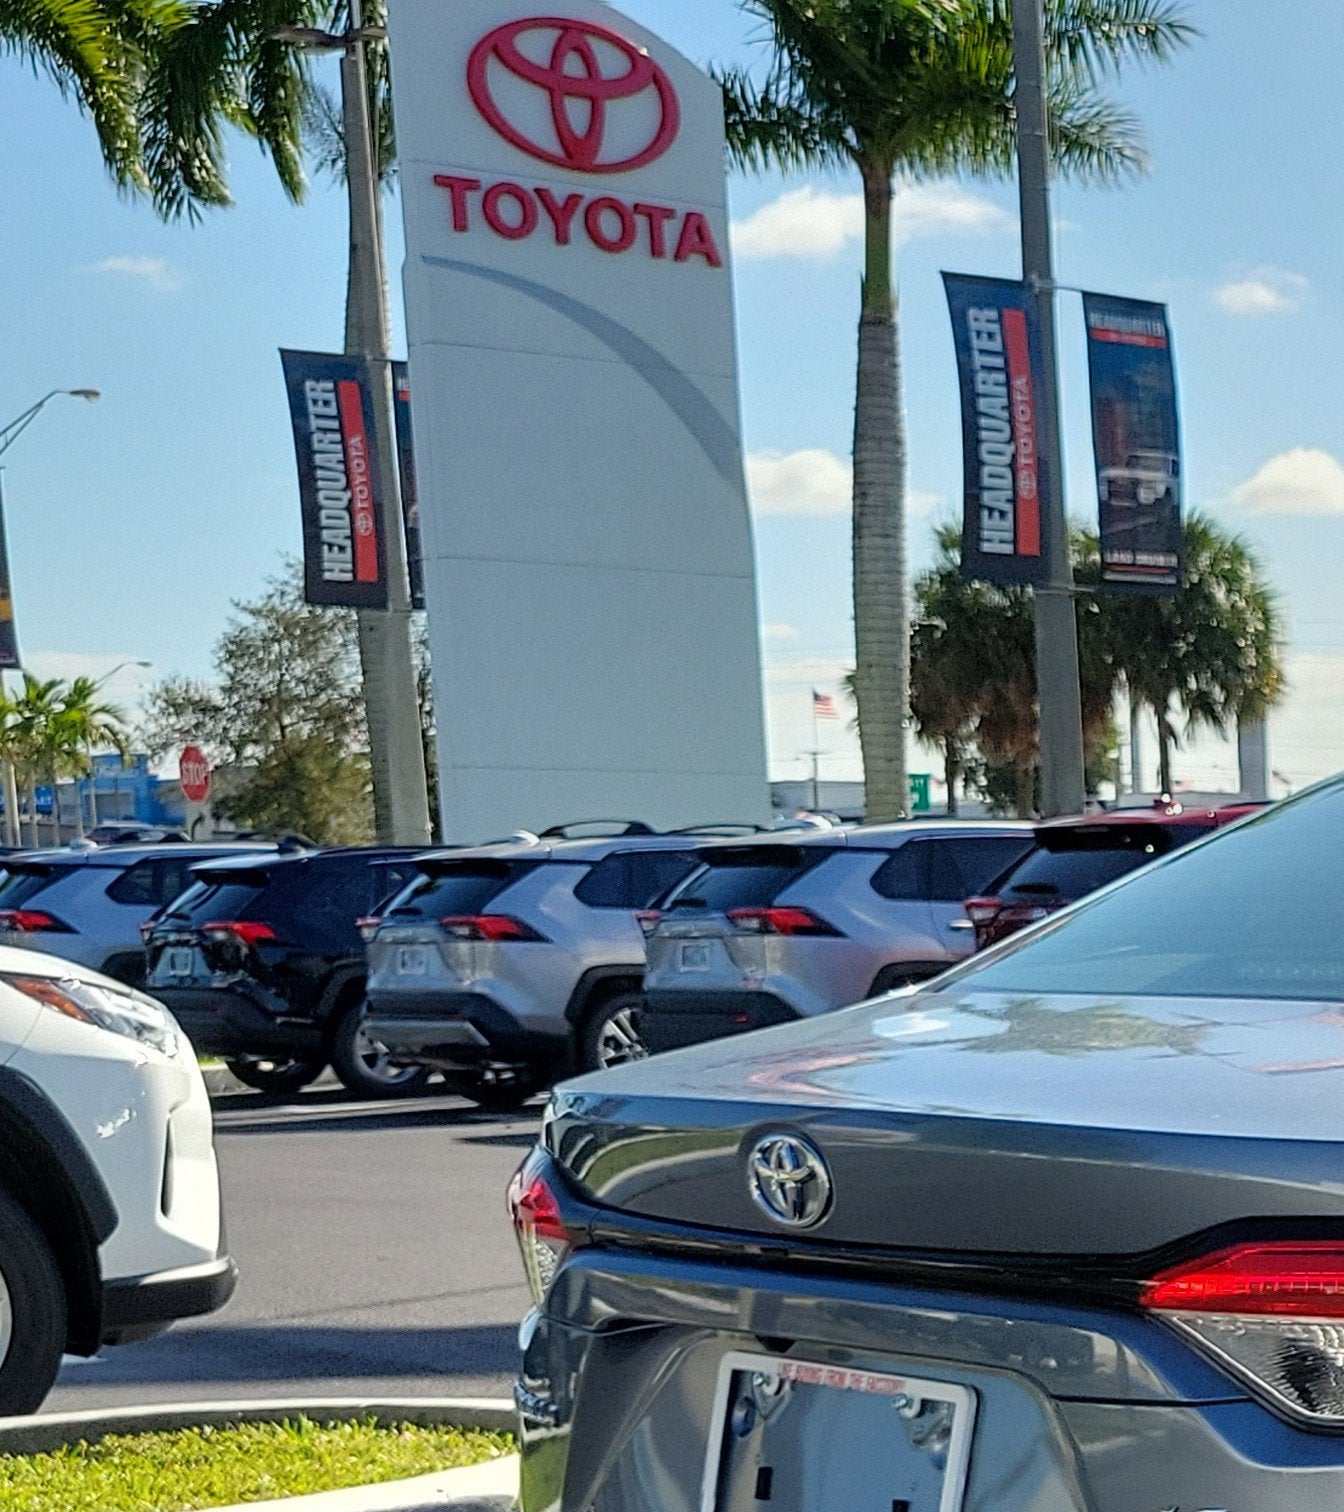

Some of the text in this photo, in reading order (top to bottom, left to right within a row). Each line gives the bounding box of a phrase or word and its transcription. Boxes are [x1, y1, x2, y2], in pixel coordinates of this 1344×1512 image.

[433, 174, 723, 268] TOYOTA
[349, 436, 371, 508] TOYOTA
[966, 306, 1014, 555] HEADQUARTER
[305, 379, 354, 582] HEADQUARTER
[182, 761, 207, 785] STOP
